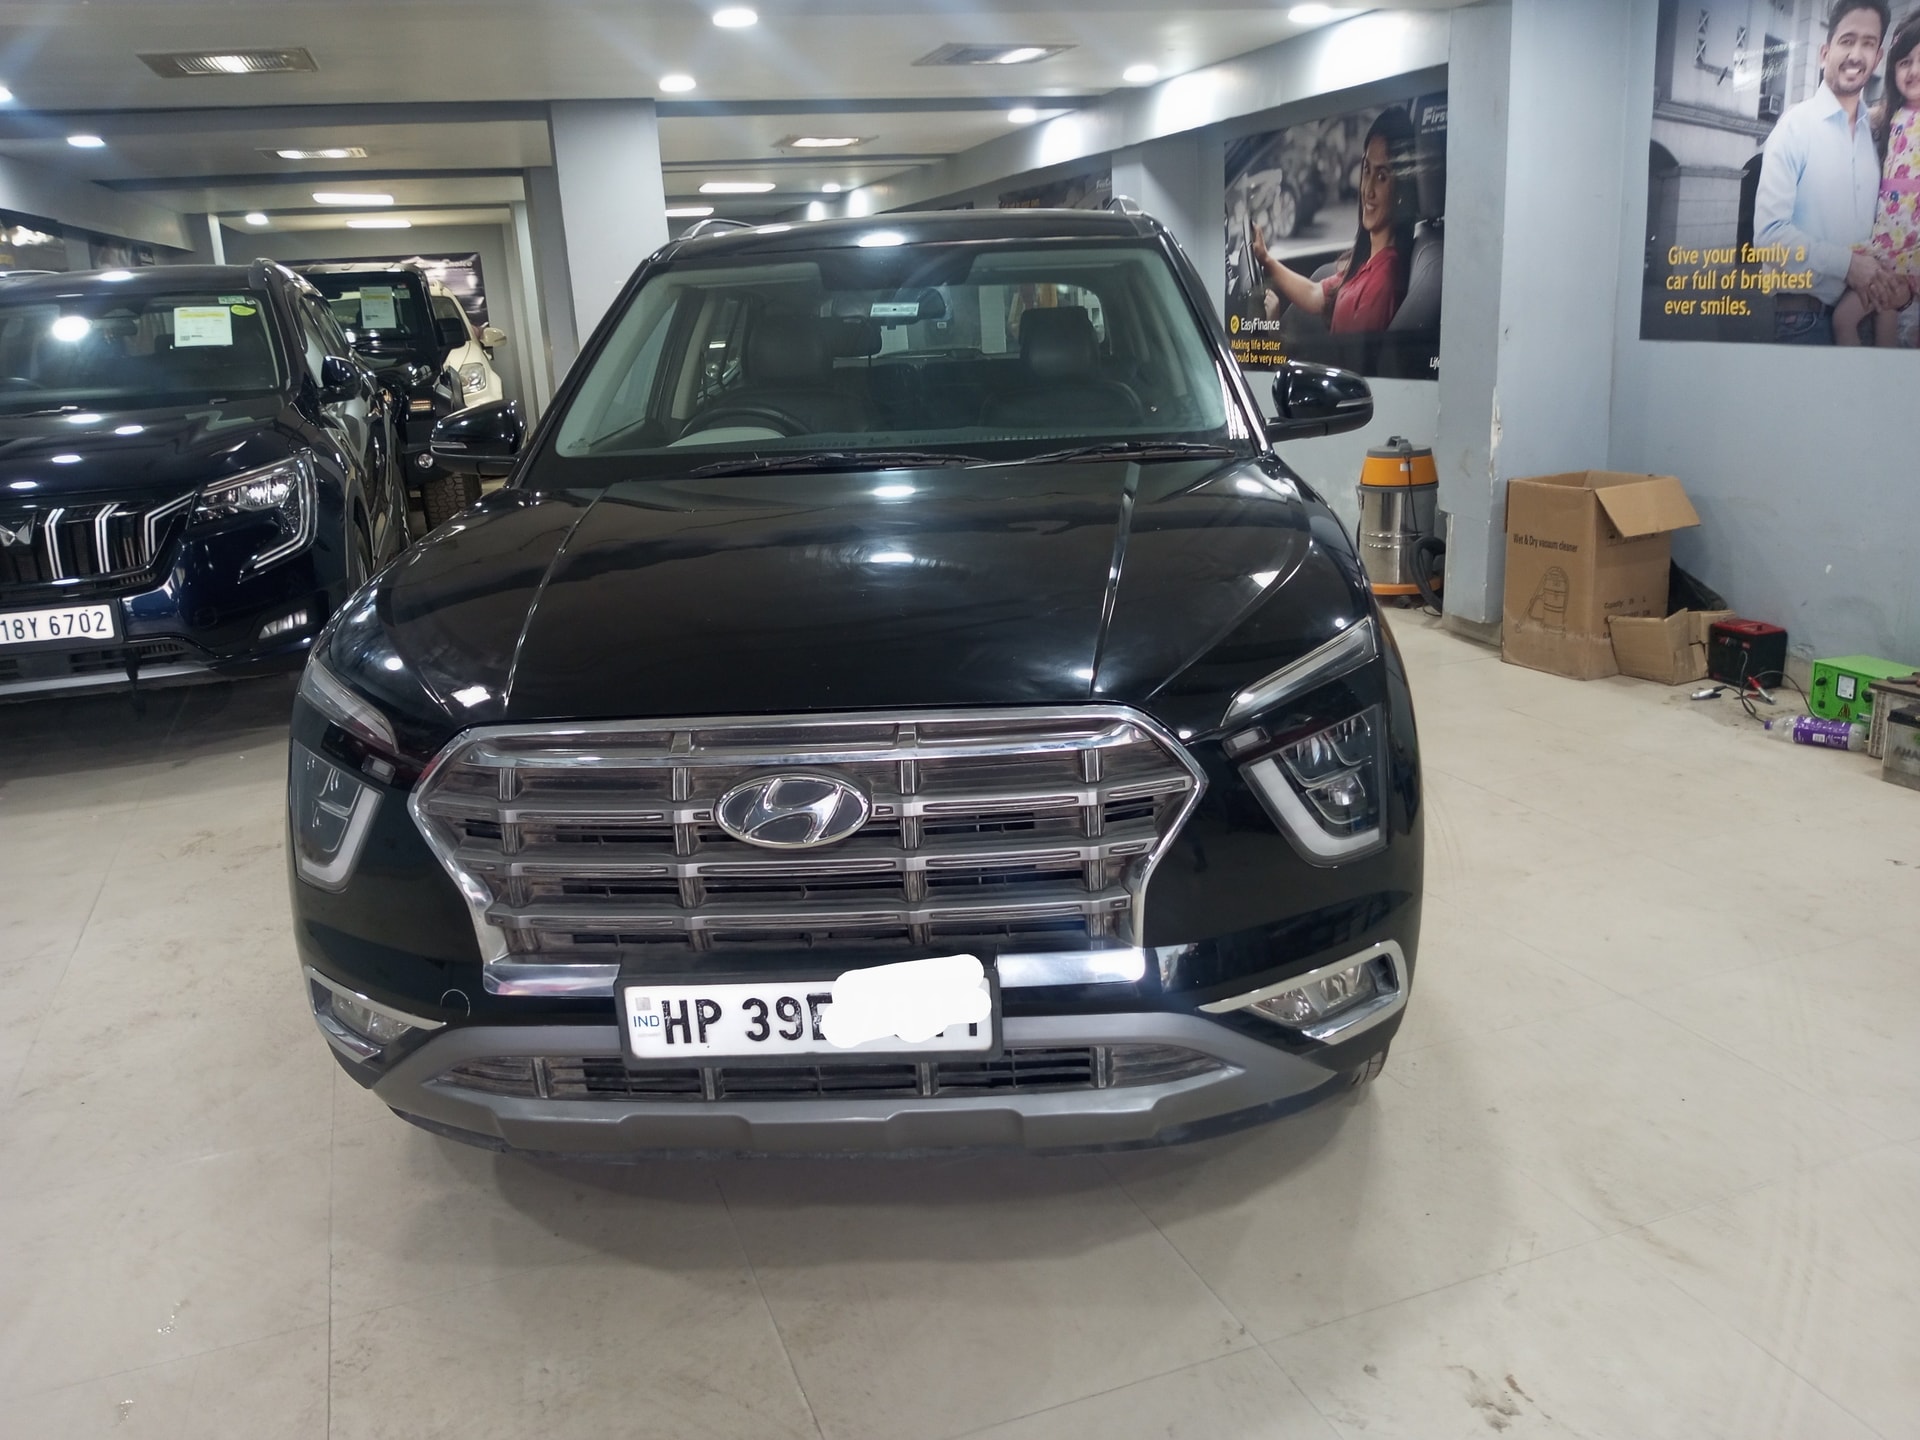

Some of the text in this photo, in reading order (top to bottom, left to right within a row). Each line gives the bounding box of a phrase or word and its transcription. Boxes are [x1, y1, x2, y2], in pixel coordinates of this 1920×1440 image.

[1668, 242, 1805, 269] Give your family a
[1666, 269, 1813, 294] car full of brightest
[1664, 296, 1751, 316] ever smiles.
[1241, 318, 1280, 333] EasyFinance
[1251, 339, 1261, 350] life
[1262, 339, 1281, 351] better
[1250, 352, 1258, 363] be
[1259, 354, 1272, 366] very
[1513, 533, 1523, 544] Wet
[1529, 535, 1538, 548] Dry
[1559, 541, 1578, 552] cleaner
[49, 611, 107, 636] 6702
[633, 1015, 660, 1028] IND
[662, 998, 722, 1044] HP
